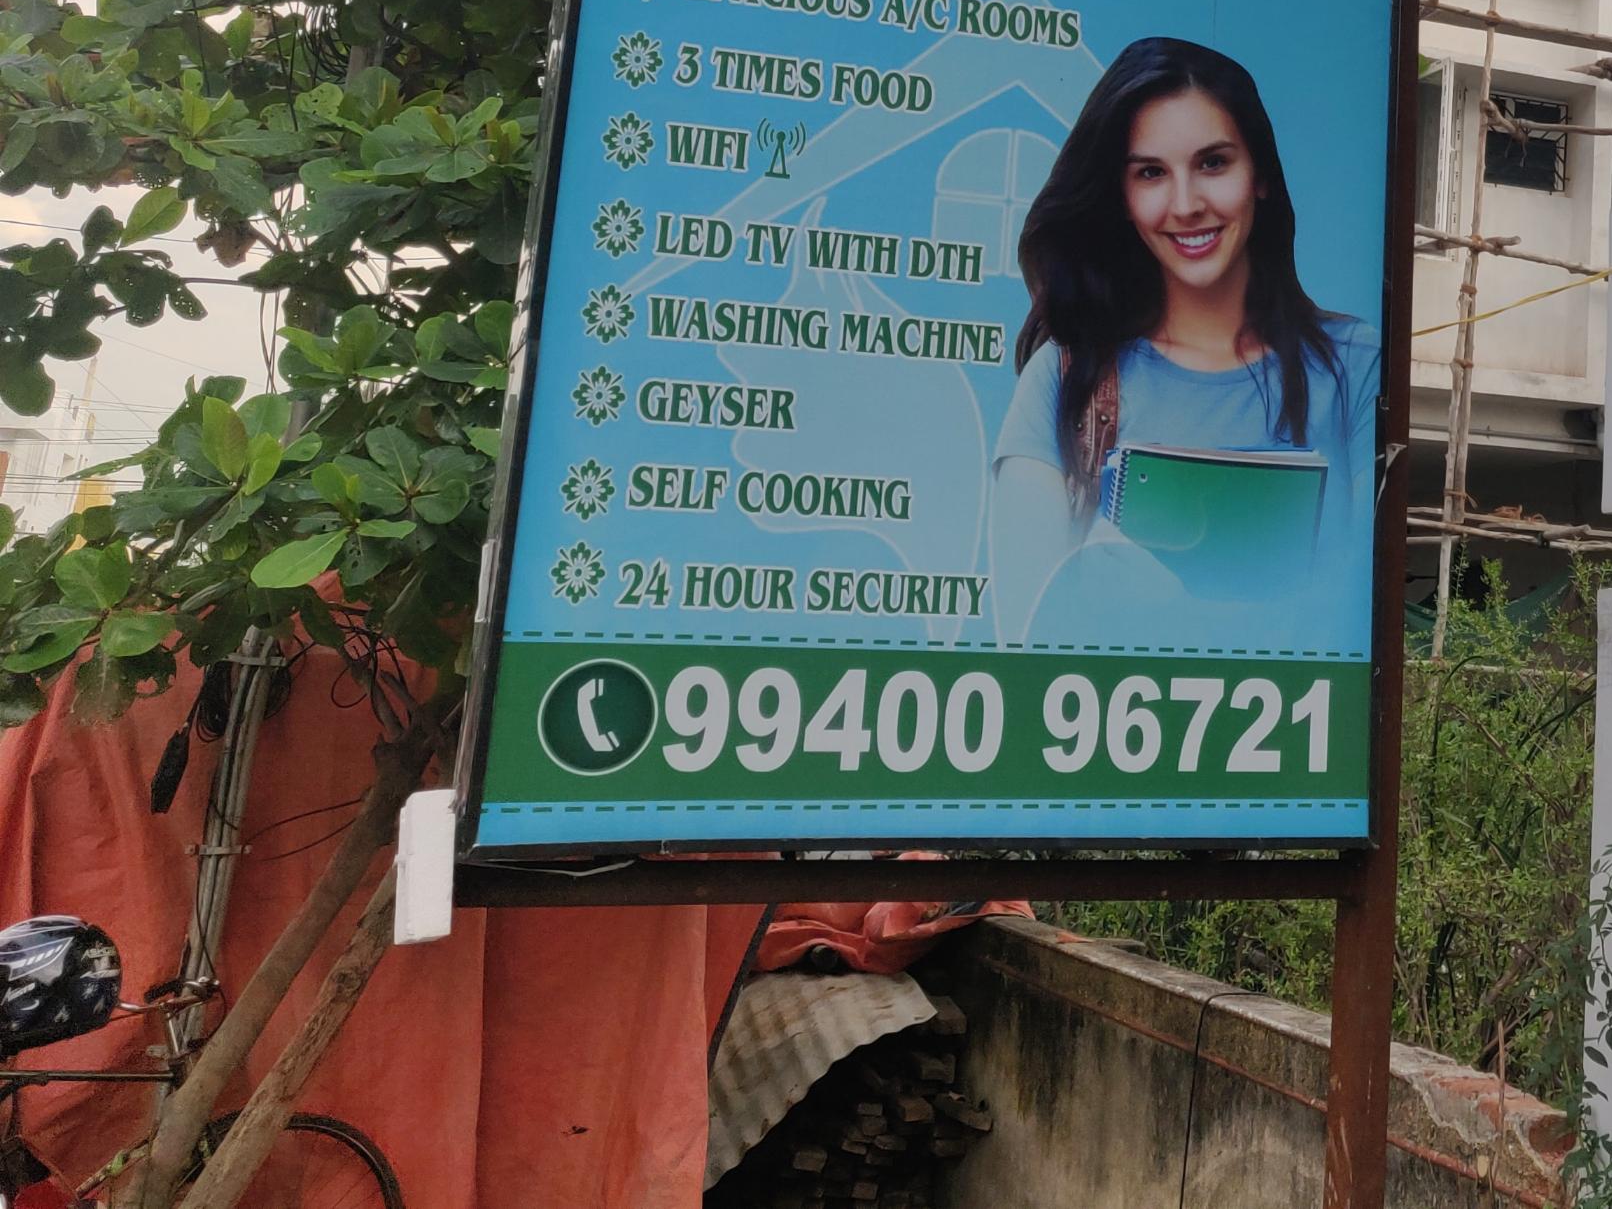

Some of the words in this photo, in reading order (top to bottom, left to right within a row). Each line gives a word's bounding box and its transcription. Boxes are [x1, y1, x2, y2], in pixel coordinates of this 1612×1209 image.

[677, 45, 699, 85] 3
[712, 52, 821, 98] TIMES
[832, 65, 932, 112] FOOD
[668, 124, 749, 170] WIFI
[654, 214, 733, 260] LED
[747, 222, 794, 266] TV
[807, 229, 900, 275] WITH
[909, 239, 983, 282] DTH
[650, 297, 828, 349] WASHING
[840, 315, 1005, 362] MACHINE
[638, 380, 795, 429] GEYSER
[629, 466, 728, 511] SELF
[738, 472, 910, 519] COOKING
[619, 562, 669, 608] 24
[683, 565, 793, 611] HOUR
[807, 569, 988, 616] SECURITY
[663, 666, 1004, 773] 99400
[1043, 673, 1329, 773] 96721
